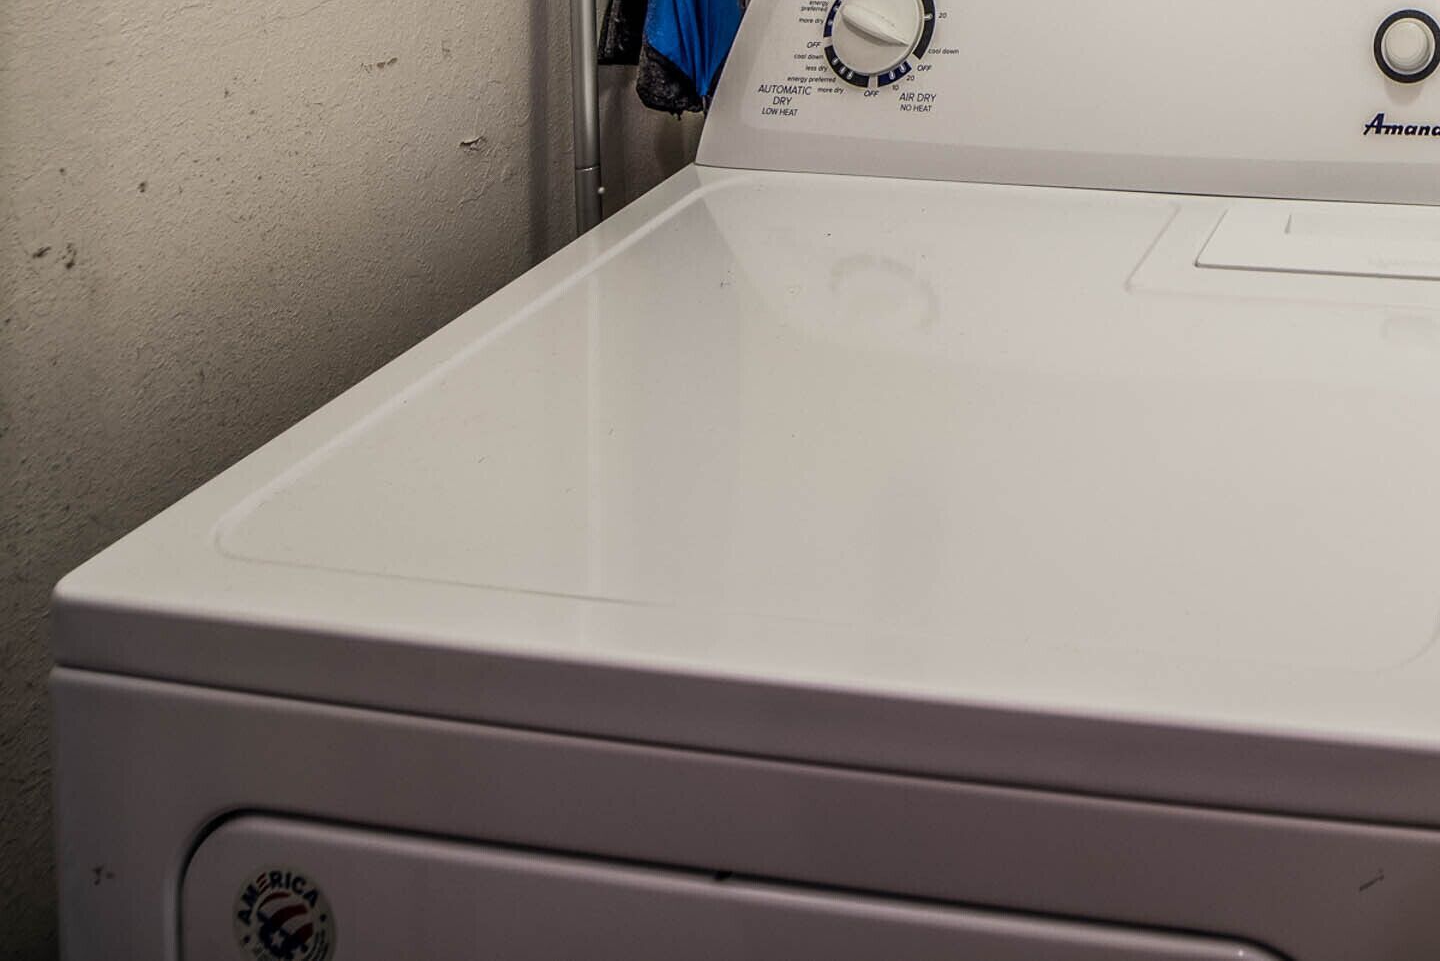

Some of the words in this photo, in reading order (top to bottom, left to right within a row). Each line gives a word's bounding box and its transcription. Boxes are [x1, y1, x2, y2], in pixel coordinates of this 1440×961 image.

[758, 84, 812, 95] AUTOMATIC
[773, 96, 792, 105] DRY
[899, 93, 915, 102] AIR
[917, 94, 936, 102] DRY
[762, 107, 778, 115] LOW
[780, 108, 798, 116] HEAT
[913, 104, 932, 112] HEAT
[238, 870, 319, 925] AMERICA
